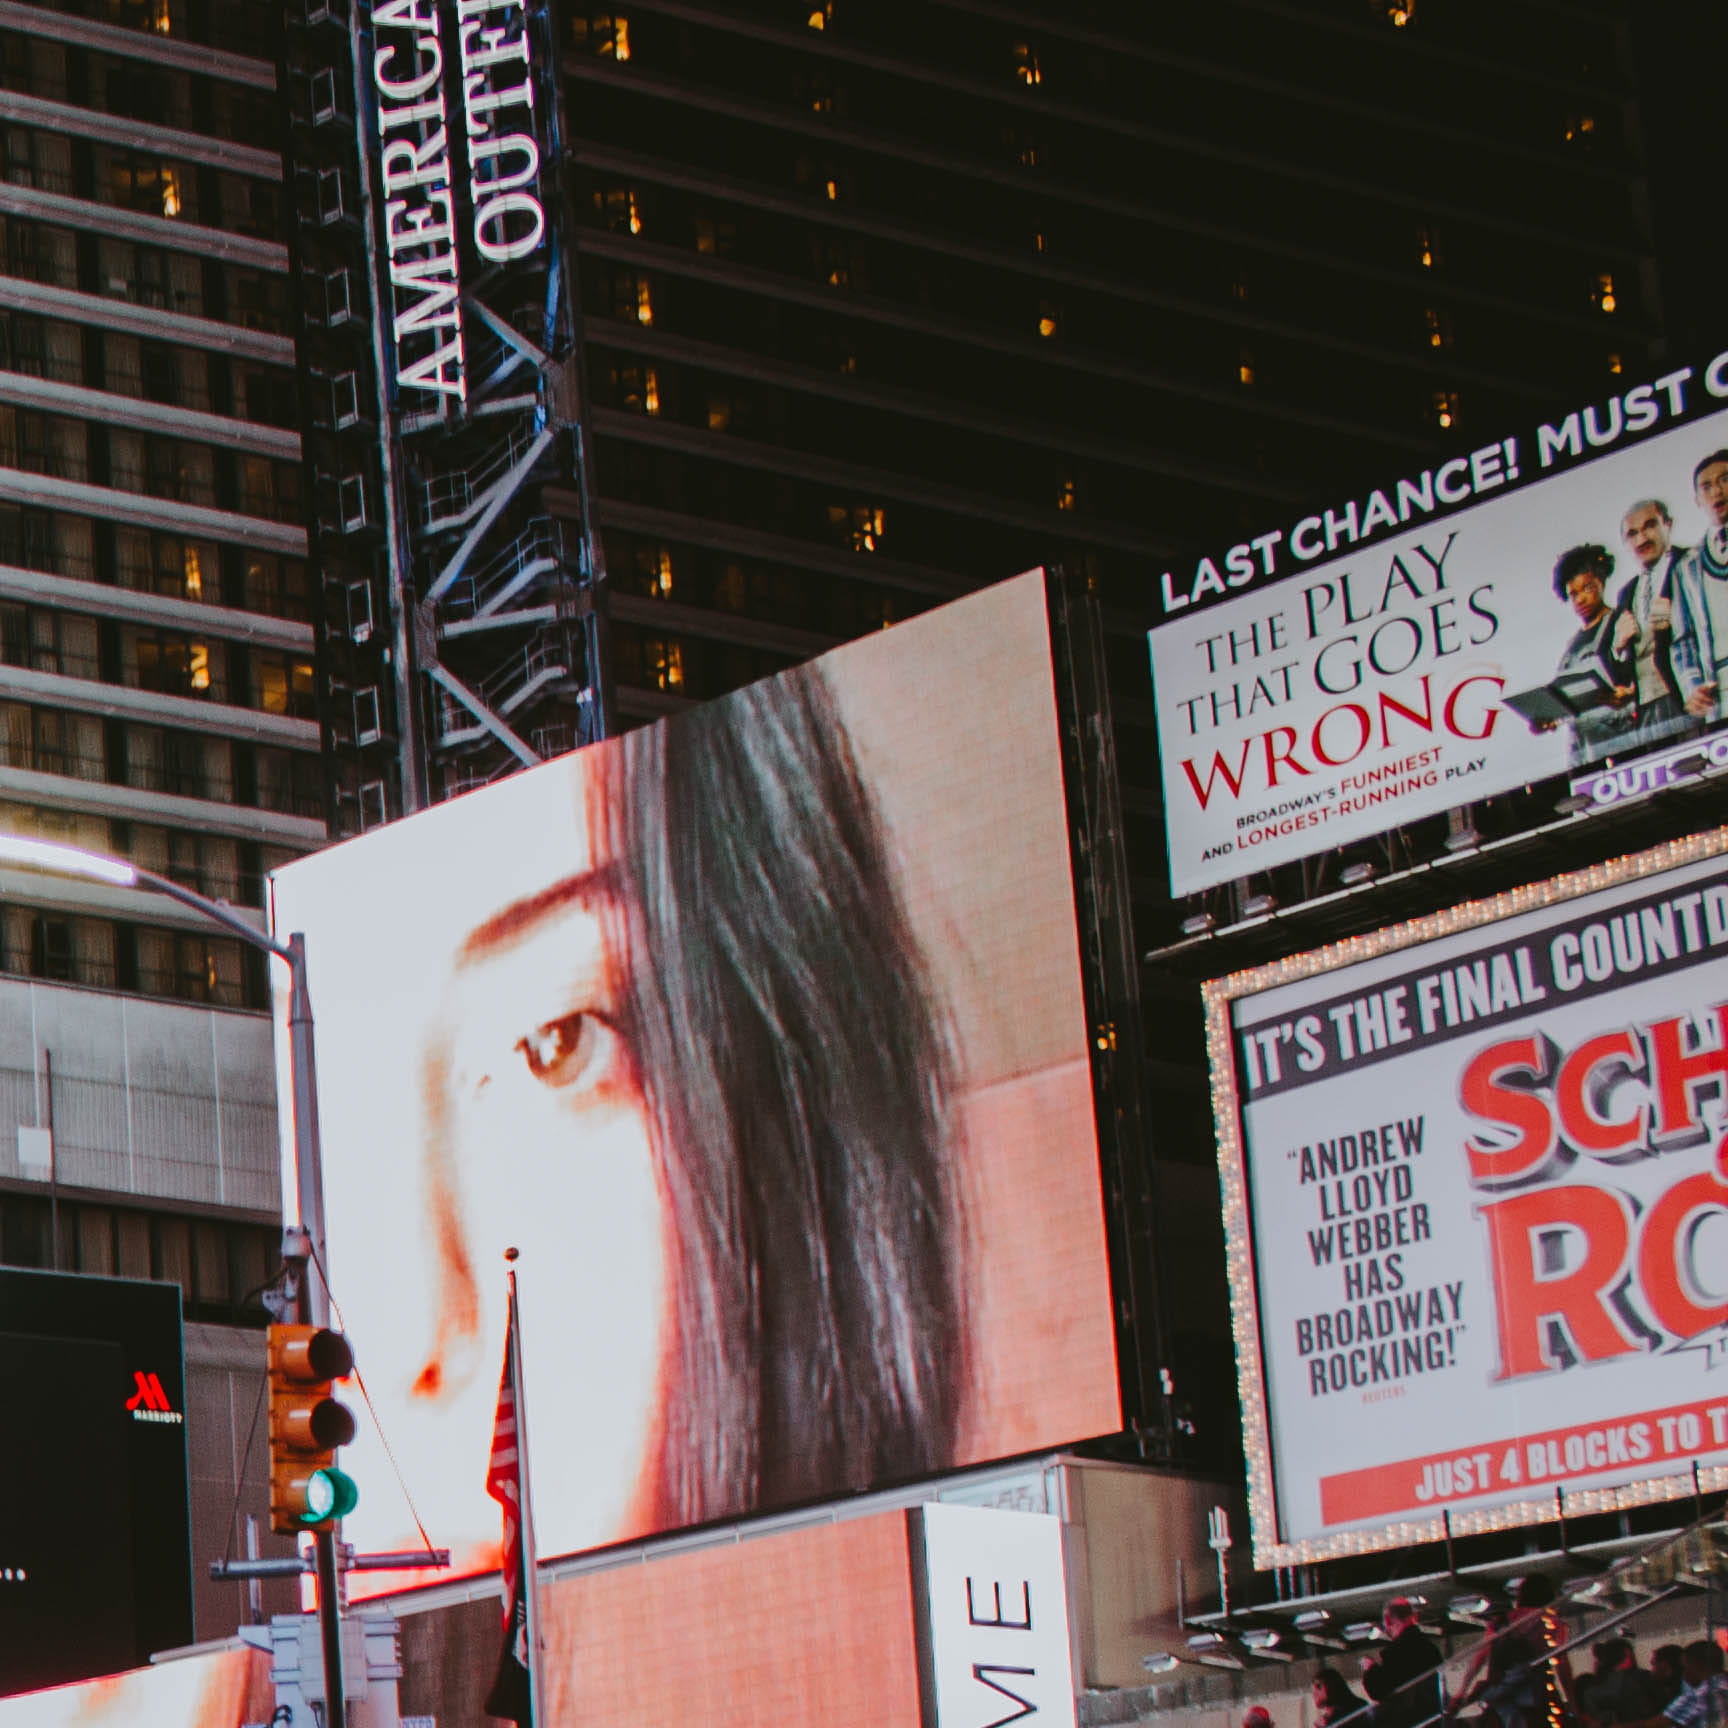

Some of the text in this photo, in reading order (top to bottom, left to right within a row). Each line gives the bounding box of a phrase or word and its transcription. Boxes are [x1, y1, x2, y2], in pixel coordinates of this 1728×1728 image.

[372, 0, 467, 403] AMERICA
[1160, 531, 1282, 612] LAST
[1289, 437, 1521, 559] CHANCE!
[1537, 367, 1693, 468] MUST
[1195, 532, 1462, 676] THE PLAY
[1177, 583, 1501, 736] THAT GOES
[1180, 674, 1507, 812] WRONG
[1236, 747, 1443, 828] BROADWAY'S FUNNIEST
[1202, 757, 1488, 862] AND LONGEST-RUNNING PLAY
[1244, 1015, 1324, 1085] IT'S
[1328, 993, 1412, 1062] THE
[1417, 945, 1546, 1036] FINAL
[1308, 1204, 1432, 1267] WEBBER
[1320, 1163, 1413, 1222] LLOYD
[1296, 1281, 1464, 1357] BROADWAY
[1345, 1254, 1404, 1302] HAS
[132, 1409, 183, 1424] MARRIOTT
[1415, 1455, 1490, 1501] JUST
[1500, 1447, 1521, 1483] 4
[1526, 1421, 1650, 1477] BLOCKS
[1657, 1413, 1701, 1454] TO
